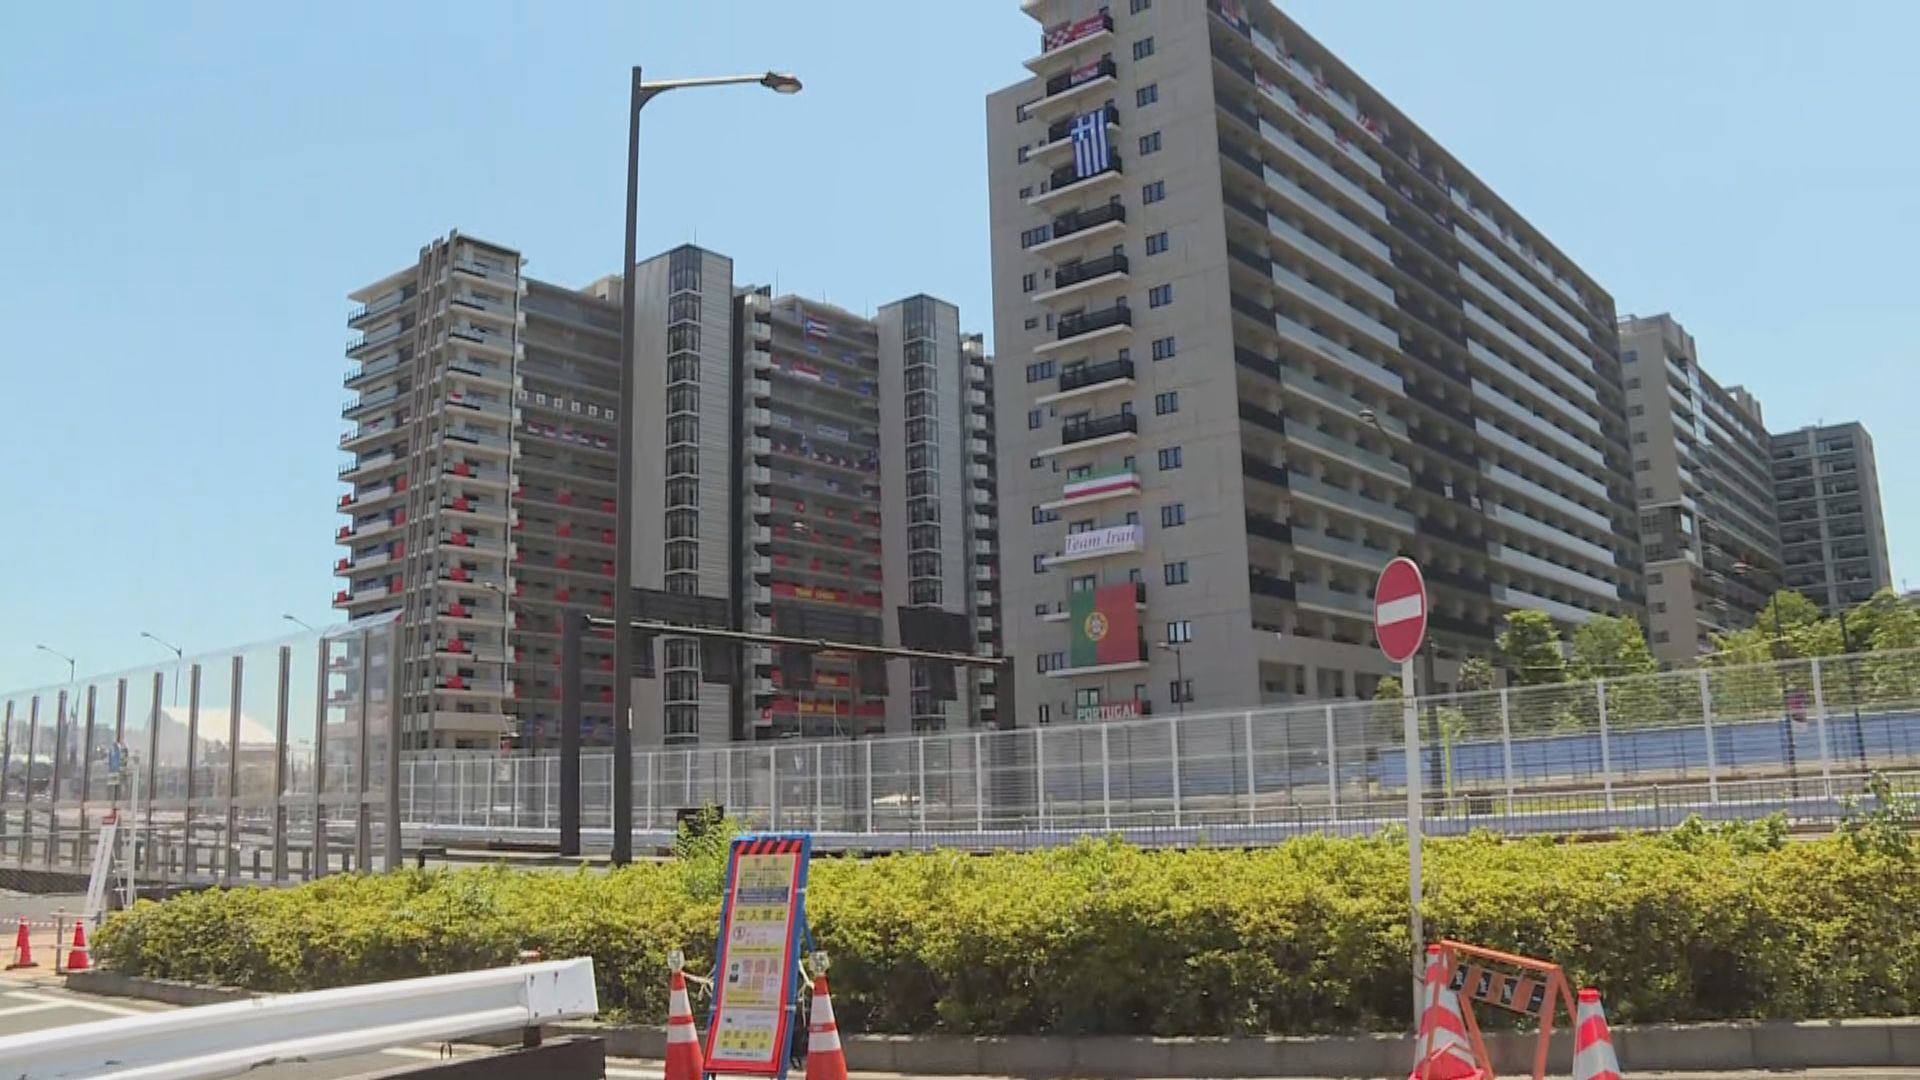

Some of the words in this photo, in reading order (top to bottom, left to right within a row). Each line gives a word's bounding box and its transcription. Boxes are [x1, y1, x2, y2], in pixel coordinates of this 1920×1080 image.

[1066, 536, 1100, 551] Team
[1107, 530, 1135, 545] Iran
[1077, 703, 1135, 721] PORTUGAL
[736, 909, 785, 921] 立入禁止
